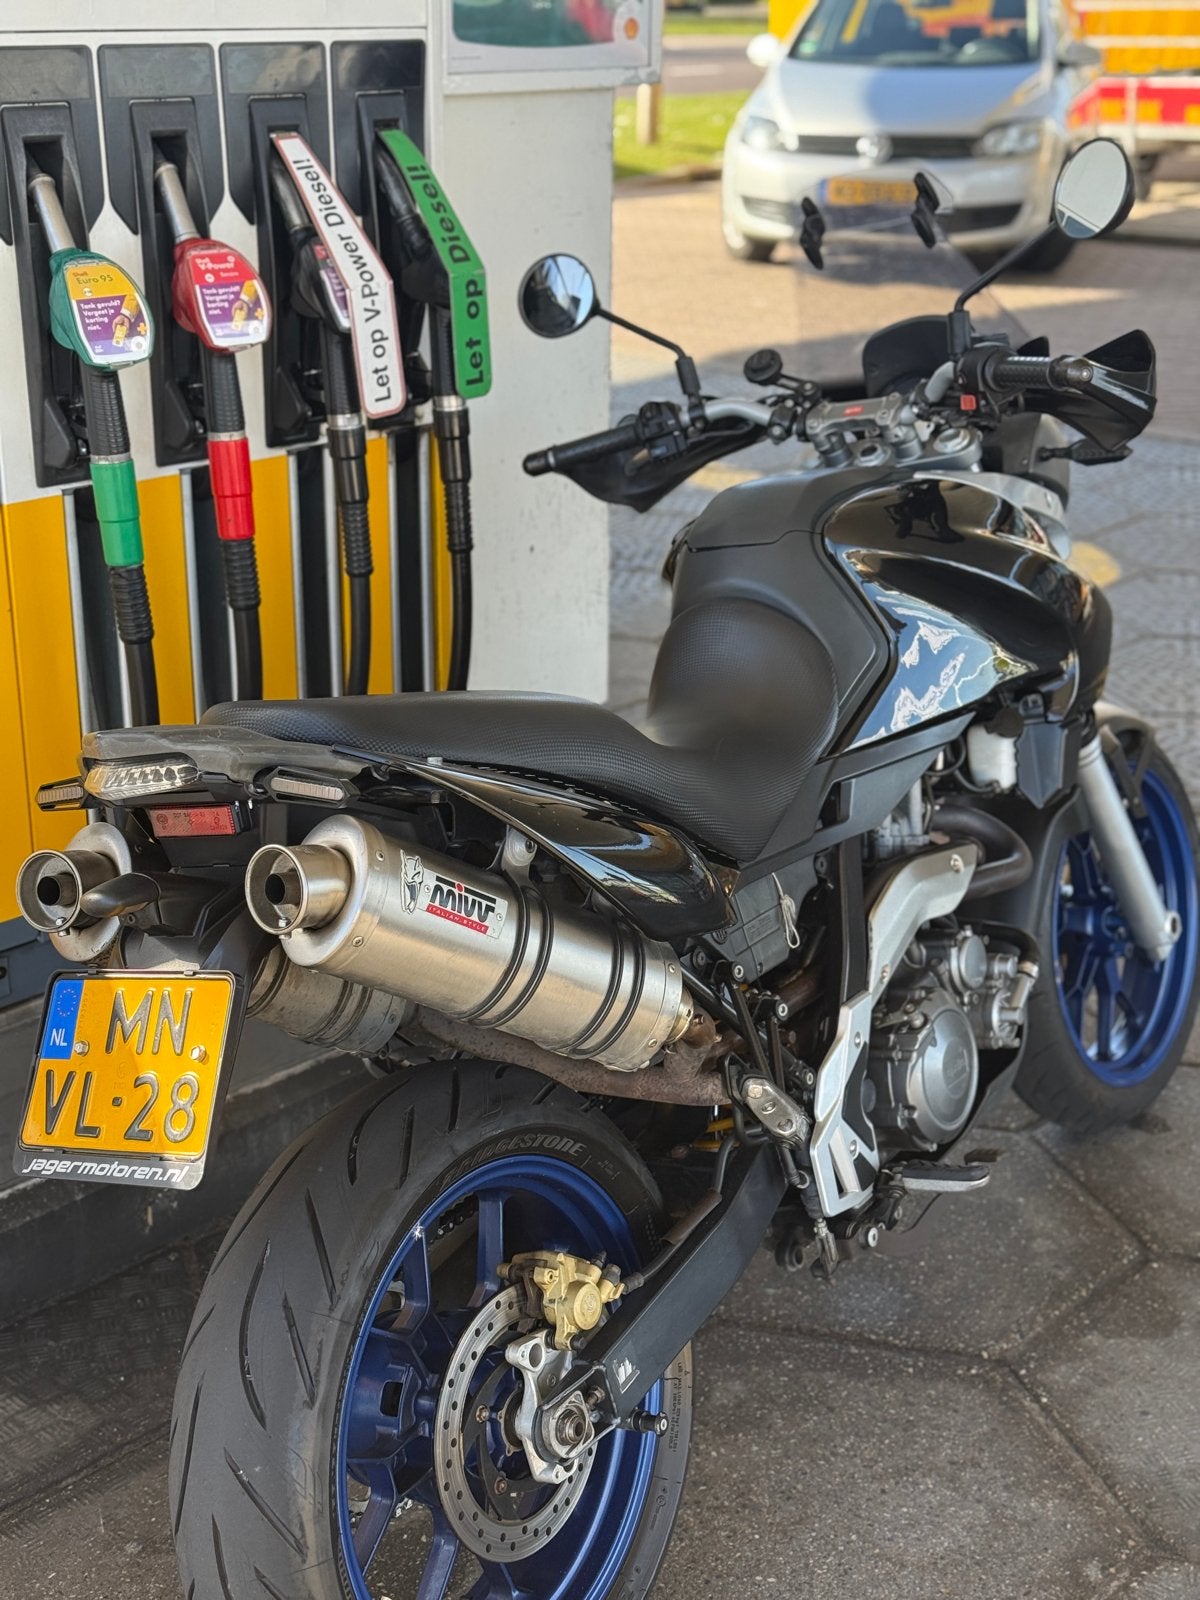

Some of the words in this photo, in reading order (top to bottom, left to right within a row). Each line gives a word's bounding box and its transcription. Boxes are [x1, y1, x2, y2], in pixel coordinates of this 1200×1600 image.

[292, 158, 346, 228] Diesel!
[406, 165, 471, 264] Diesel!
[76, 277, 99, 285] Euro
[99, 274, 114, 282] 95
[337, 232, 381, 323] V-Power
[97, 299, 121, 308] gevuld?
[108, 307, 115, 316] je
[465, 279, 483, 319] op
[85, 316, 109, 324] korting
[370, 328, 389, 359] op
[466, 338, 484, 386] Let
[372, 364, 392, 403] Let
[50, 1028, 68, 1047] NL
[105, 989, 193, 1055] MN
[22, 1158, 189, 1183] jagermotoren.nl
